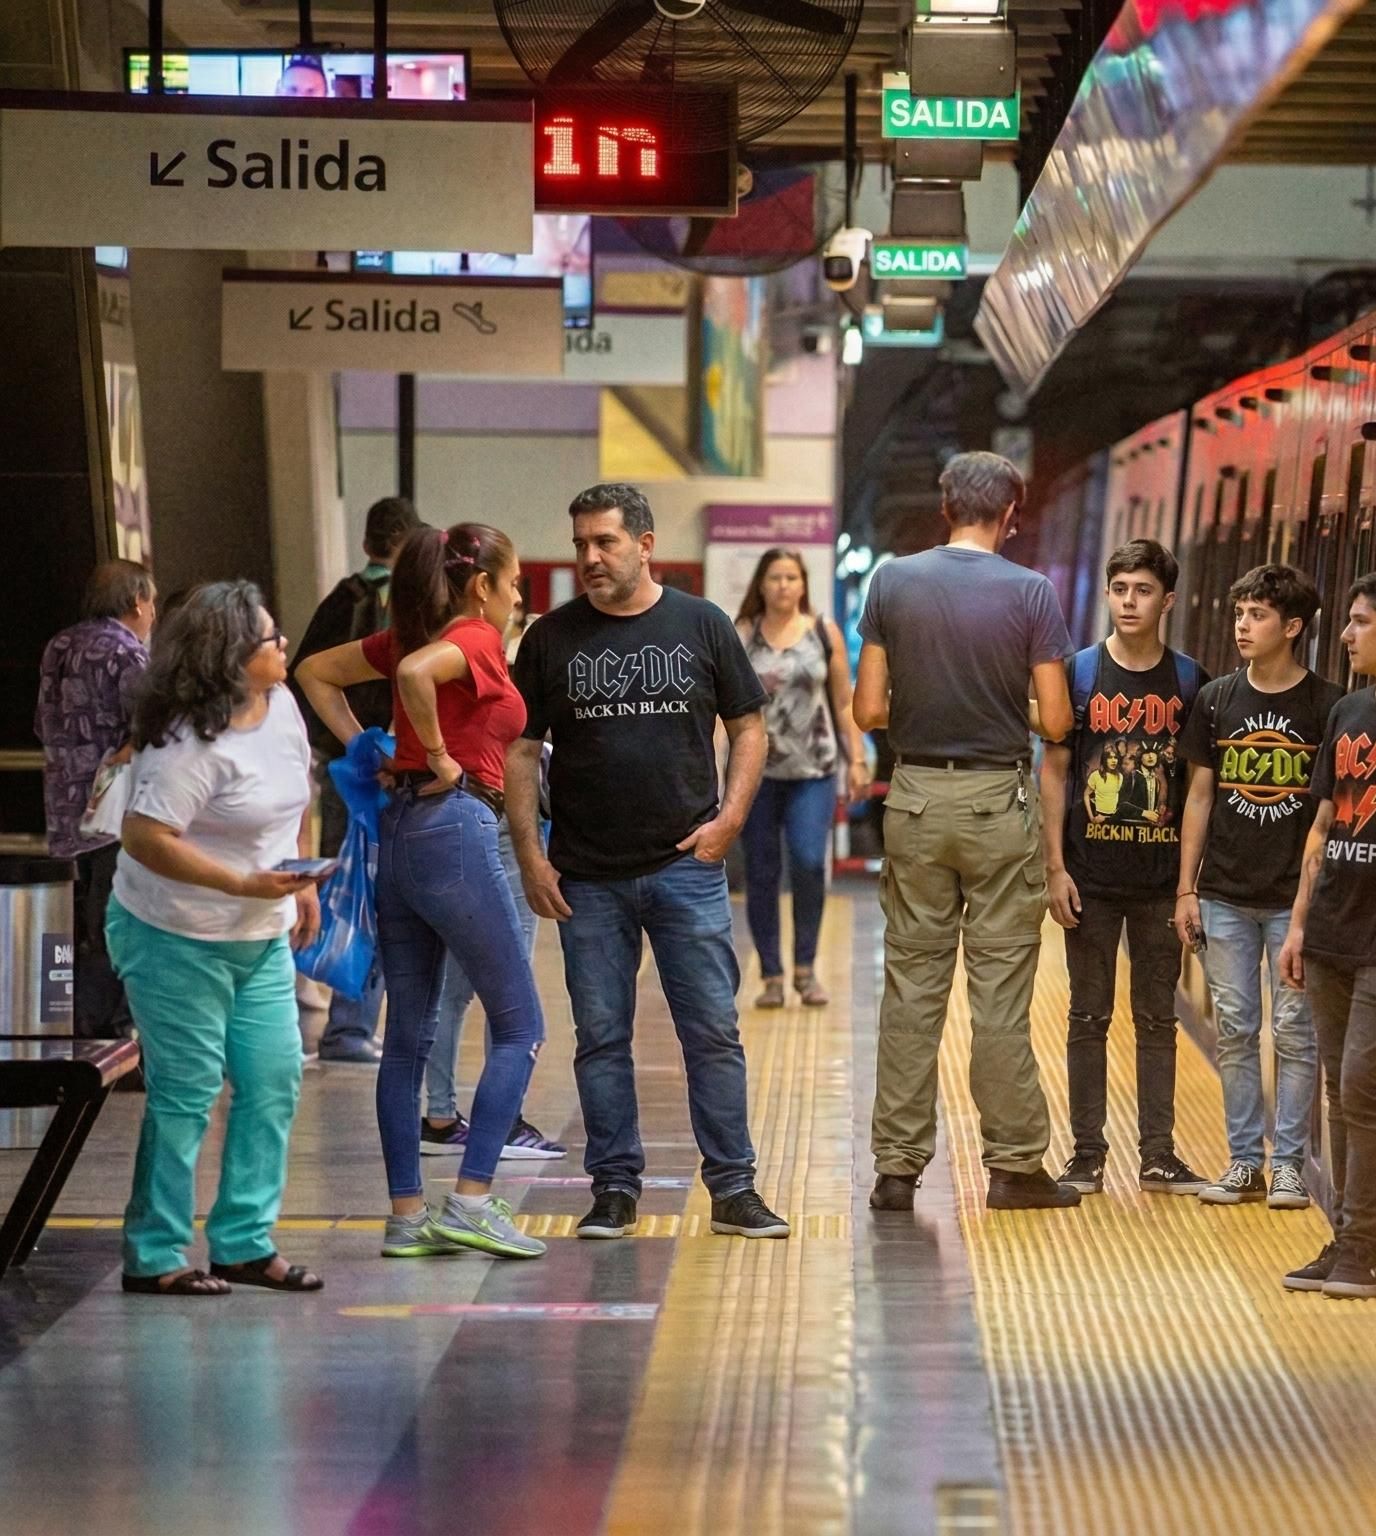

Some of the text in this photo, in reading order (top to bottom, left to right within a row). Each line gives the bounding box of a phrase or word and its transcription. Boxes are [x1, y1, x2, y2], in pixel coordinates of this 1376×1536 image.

[890, 99, 1011, 129] SALIDA
[206, 138, 388, 192] Salida
[876, 250, 962, 273] SALIDA
[325, 299, 442, 334] Salida
[565, 330, 613, 354] ida
[574, 699, 690, 720] BACK IN BLACK
